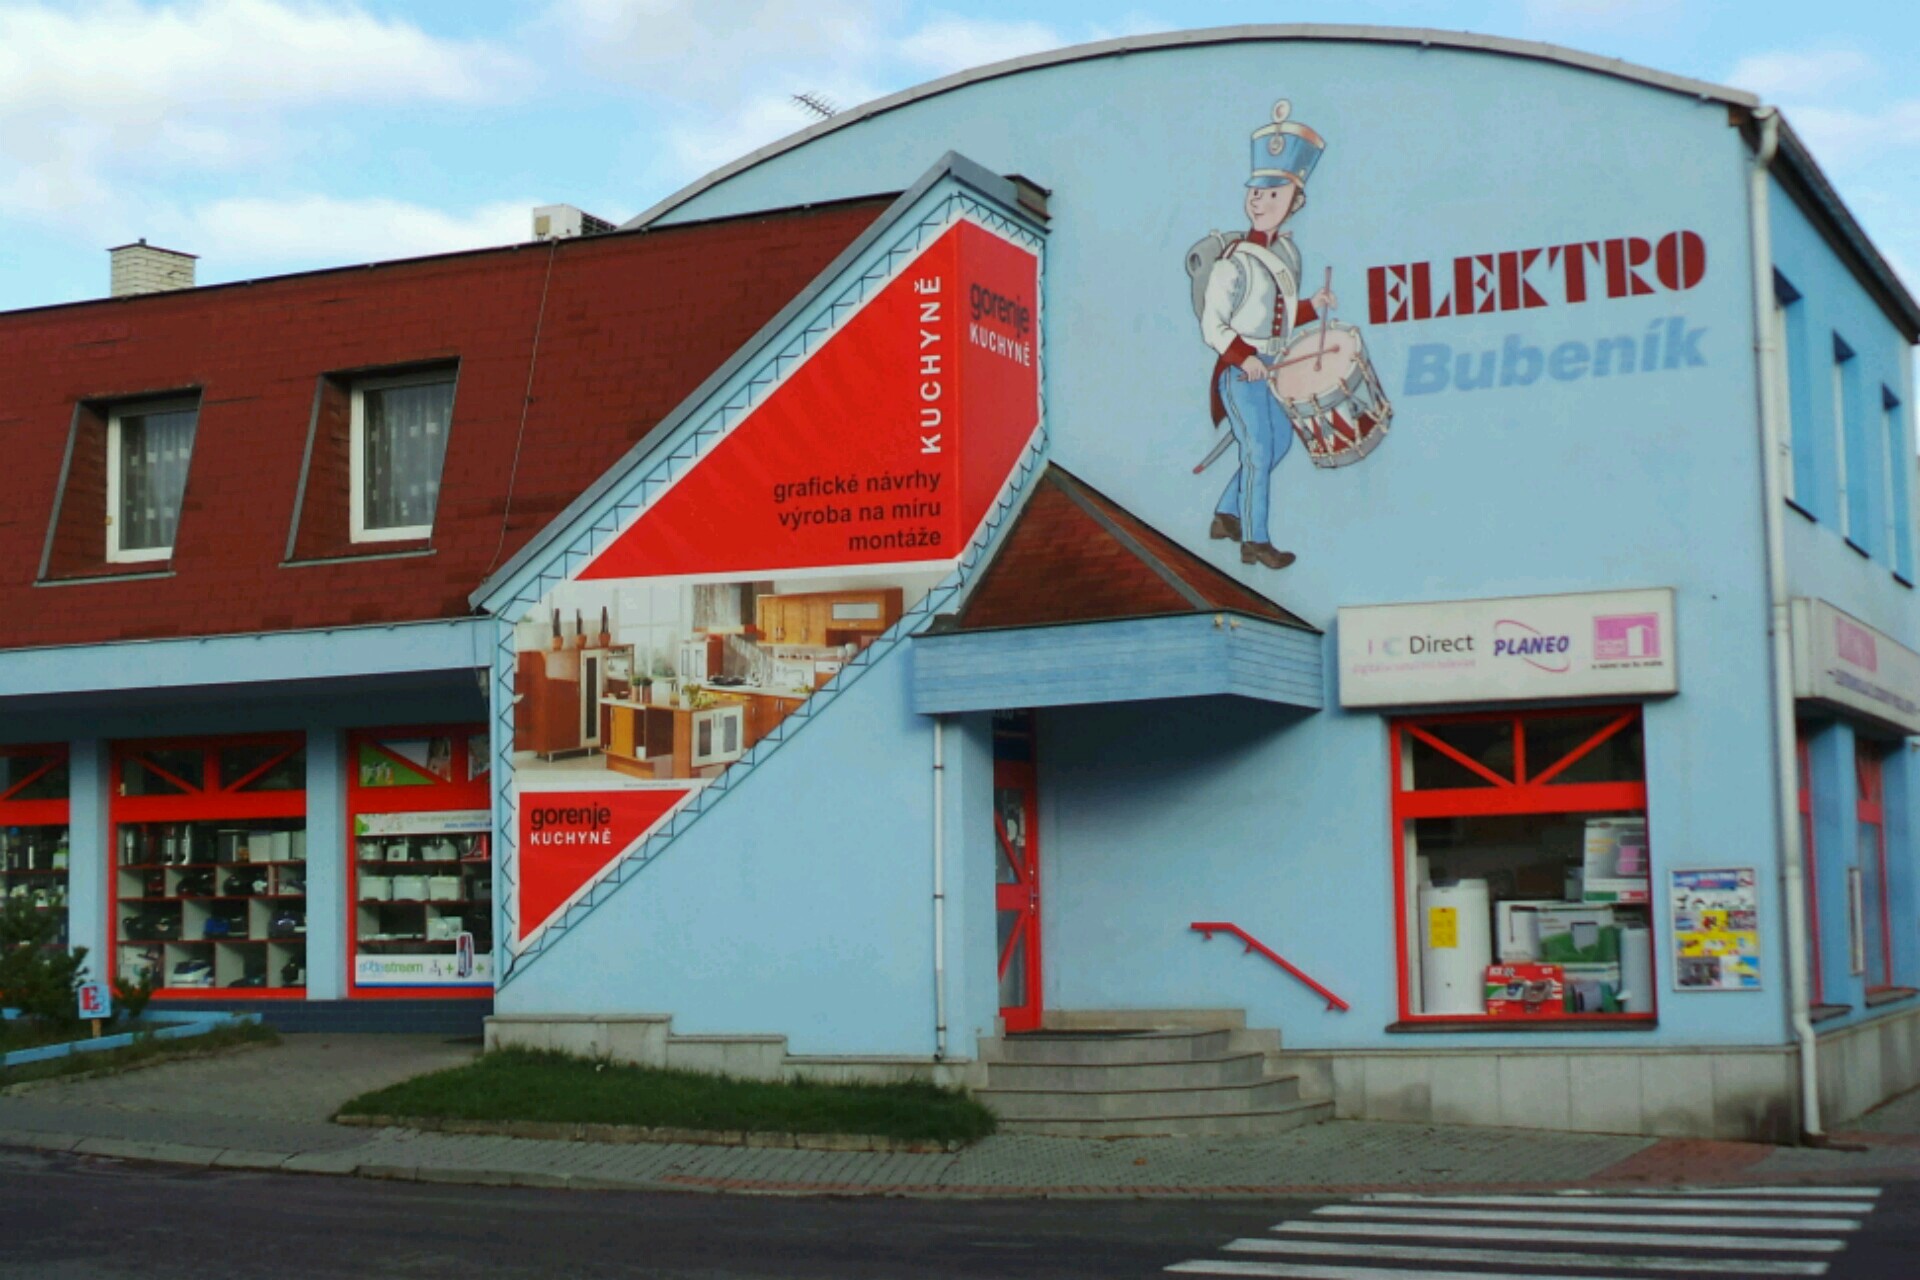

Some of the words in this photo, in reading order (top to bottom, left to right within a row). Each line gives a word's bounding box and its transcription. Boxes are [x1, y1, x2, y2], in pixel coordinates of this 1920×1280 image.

[1367, 229, 1706, 325] ELEKTRO
[969, 283, 1031, 338] gorenje
[969, 322, 1031, 367] KUCHYNĚ
[1403, 316, 1708, 396] Bubeník
[914, 275, 942, 454] KUCHYNĚ
[773, 474, 858, 503] grafické
[867, 470, 941, 496] návrhy
[778, 505, 851, 530] výroba
[859, 506, 884, 521] na
[892, 500, 941, 520] míru
[849, 529, 941, 551] montáže
[1409, 634, 1474, 655] Direct
[1493, 635, 1570, 657] PLANEO
[531, 802, 611, 831] gorenje
[530, 828, 612, 846] KUCHYNĚ
